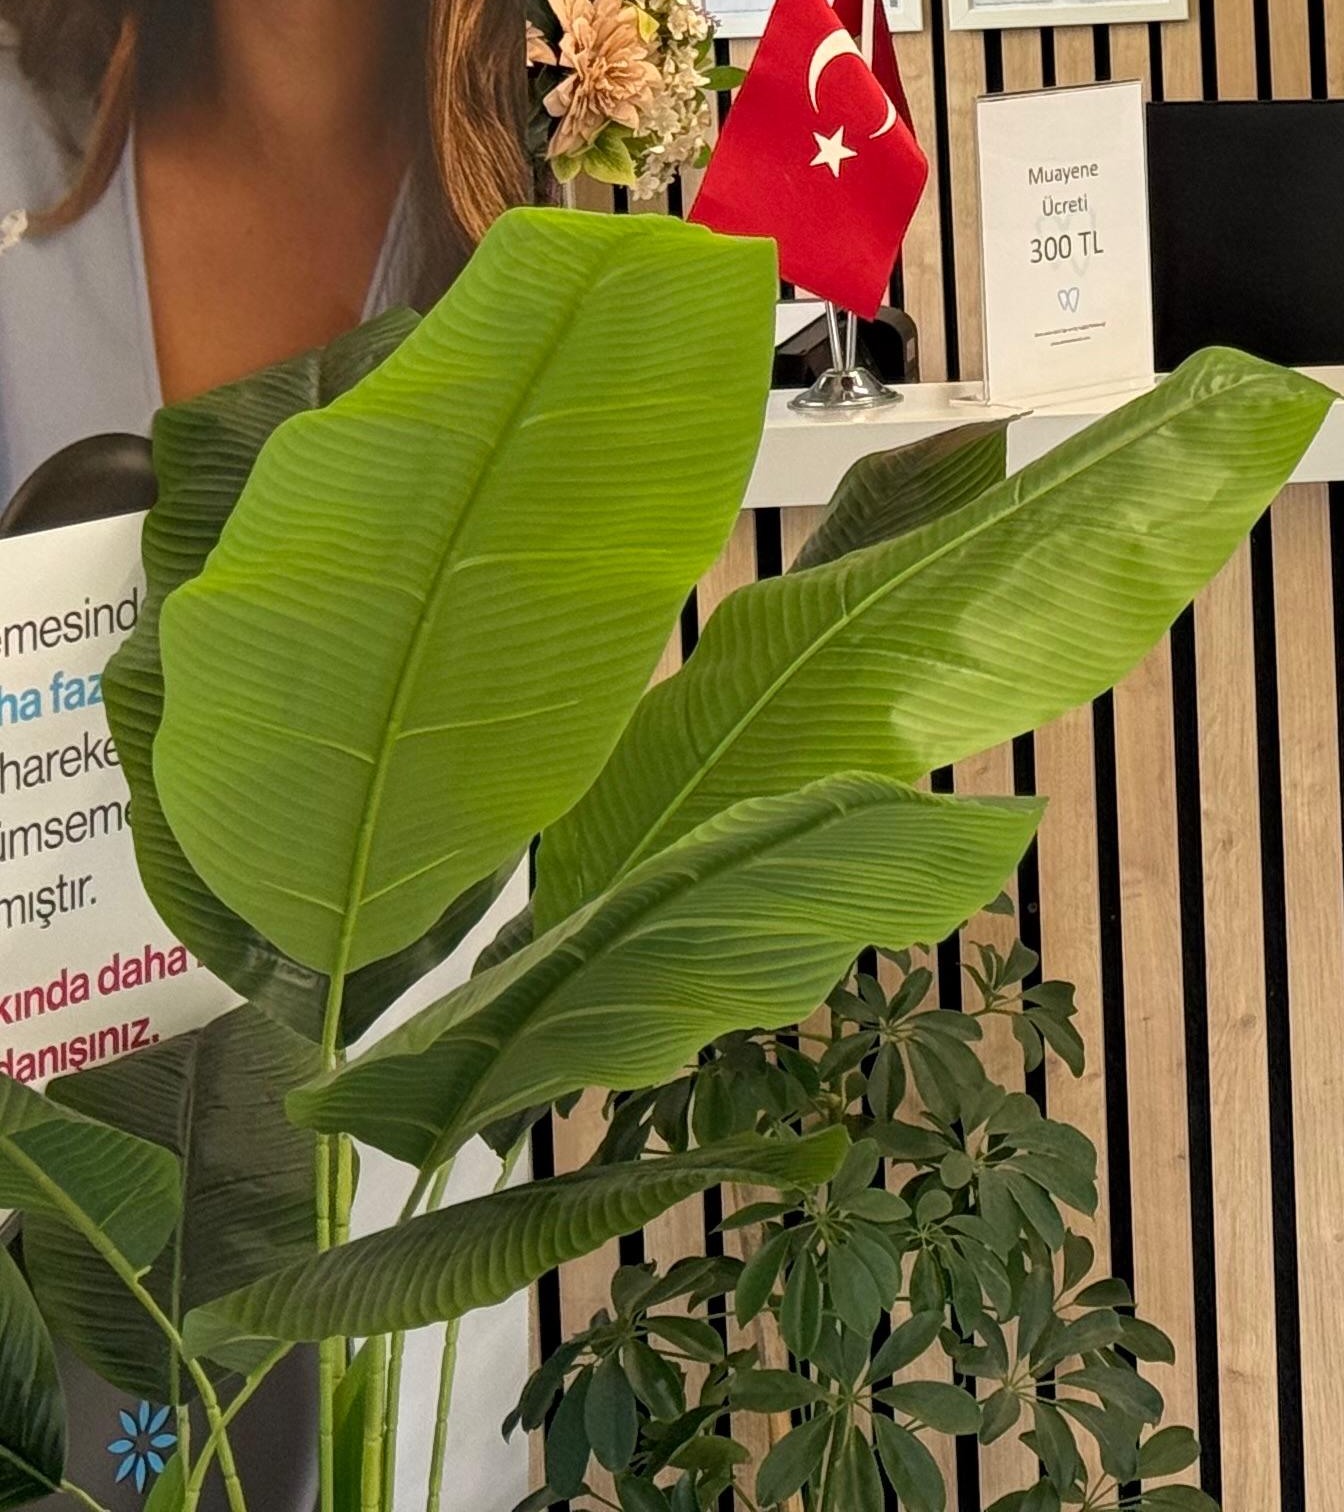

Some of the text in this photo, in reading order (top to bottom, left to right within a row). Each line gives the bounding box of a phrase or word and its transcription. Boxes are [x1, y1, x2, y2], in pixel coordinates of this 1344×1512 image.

[1028, 163, 1099, 186] Muayene
[1042, 193, 1088, 218] Ücreti
[1030, 230, 1104, 264] 300 TL
[97, 943, 188, 996] daha
